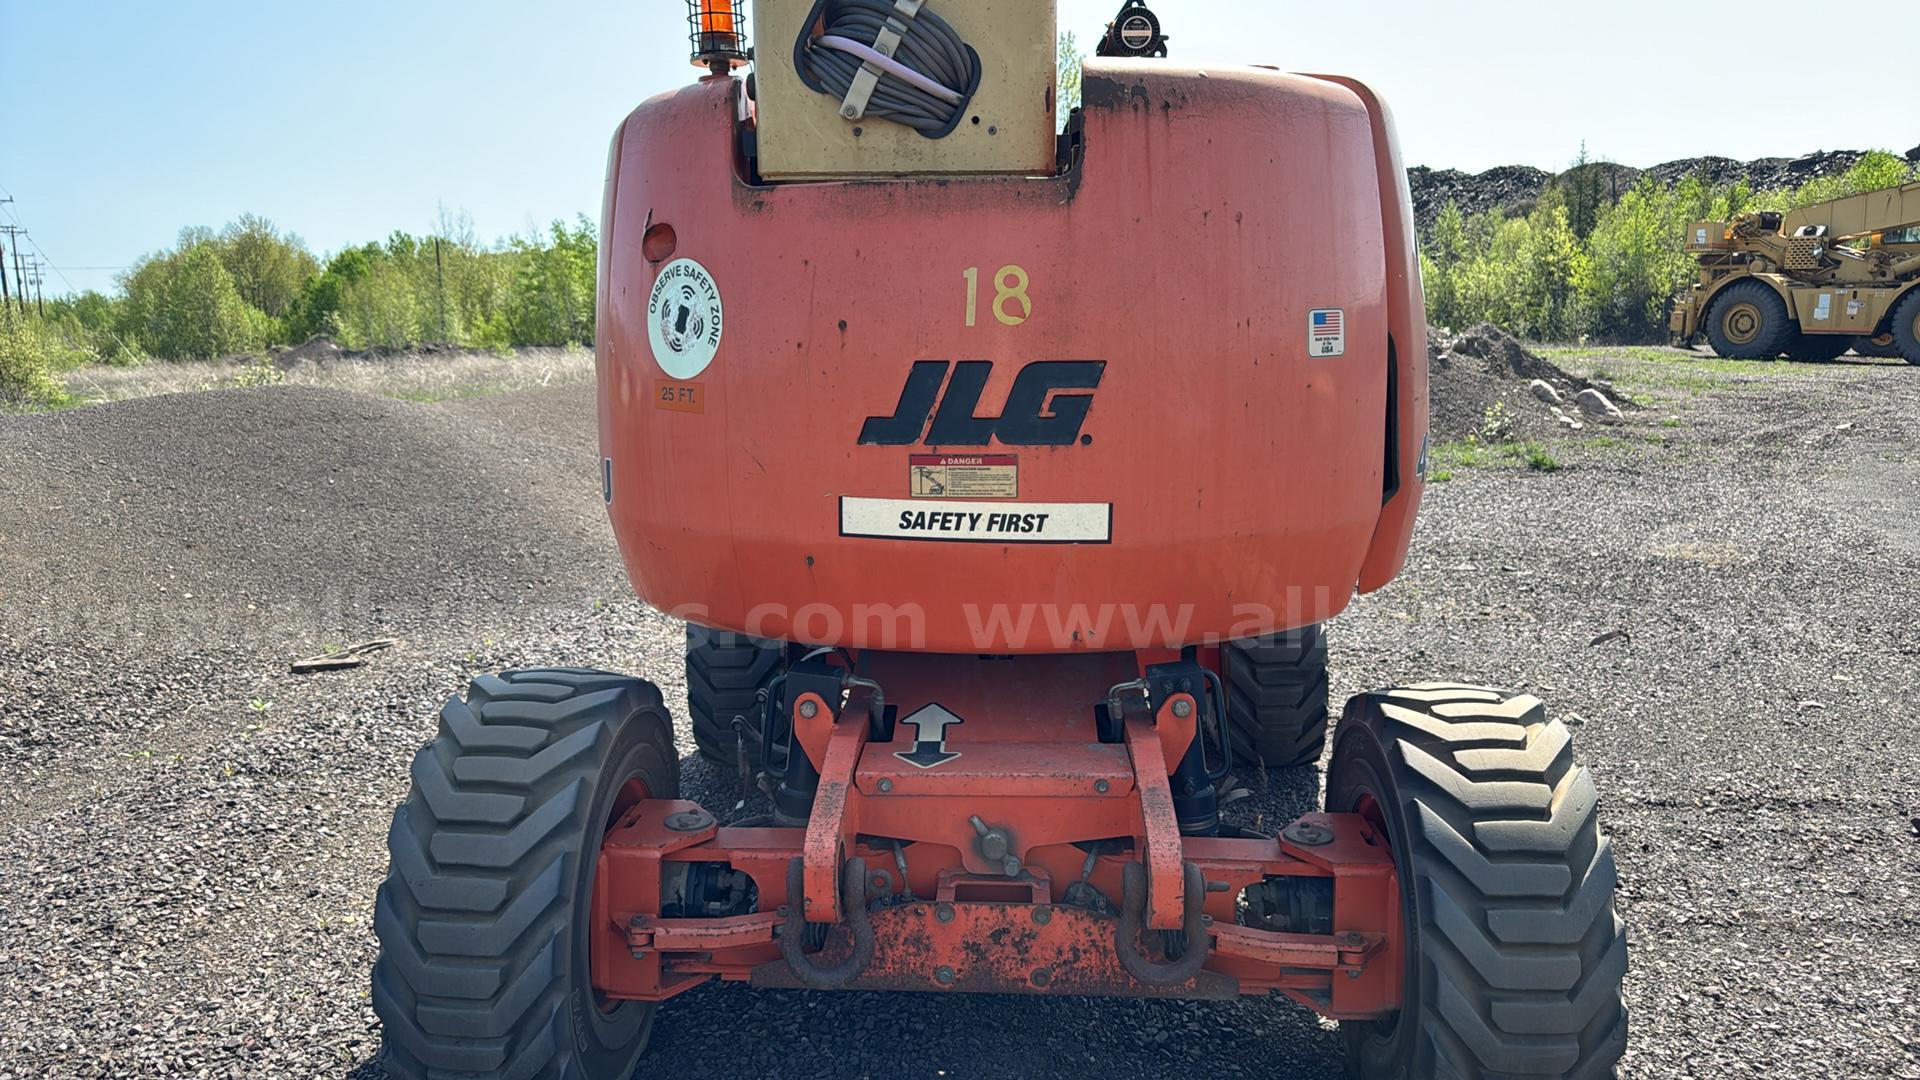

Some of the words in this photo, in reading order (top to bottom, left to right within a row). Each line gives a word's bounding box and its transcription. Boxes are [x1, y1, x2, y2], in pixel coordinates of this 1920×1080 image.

[650, 265, 682, 314] OBSERVE
[683, 265, 716, 302] SAFETY
[707, 305, 720, 348] ZONE
[962, 264, 1032, 327] 18
[661, 386, 675, 402] 25
[678, 387, 696, 404] FT.
[857, 360, 1107, 446] JLG
[899, 510, 983, 532] SAFETY
[986, 513, 1049, 533] FIRST
